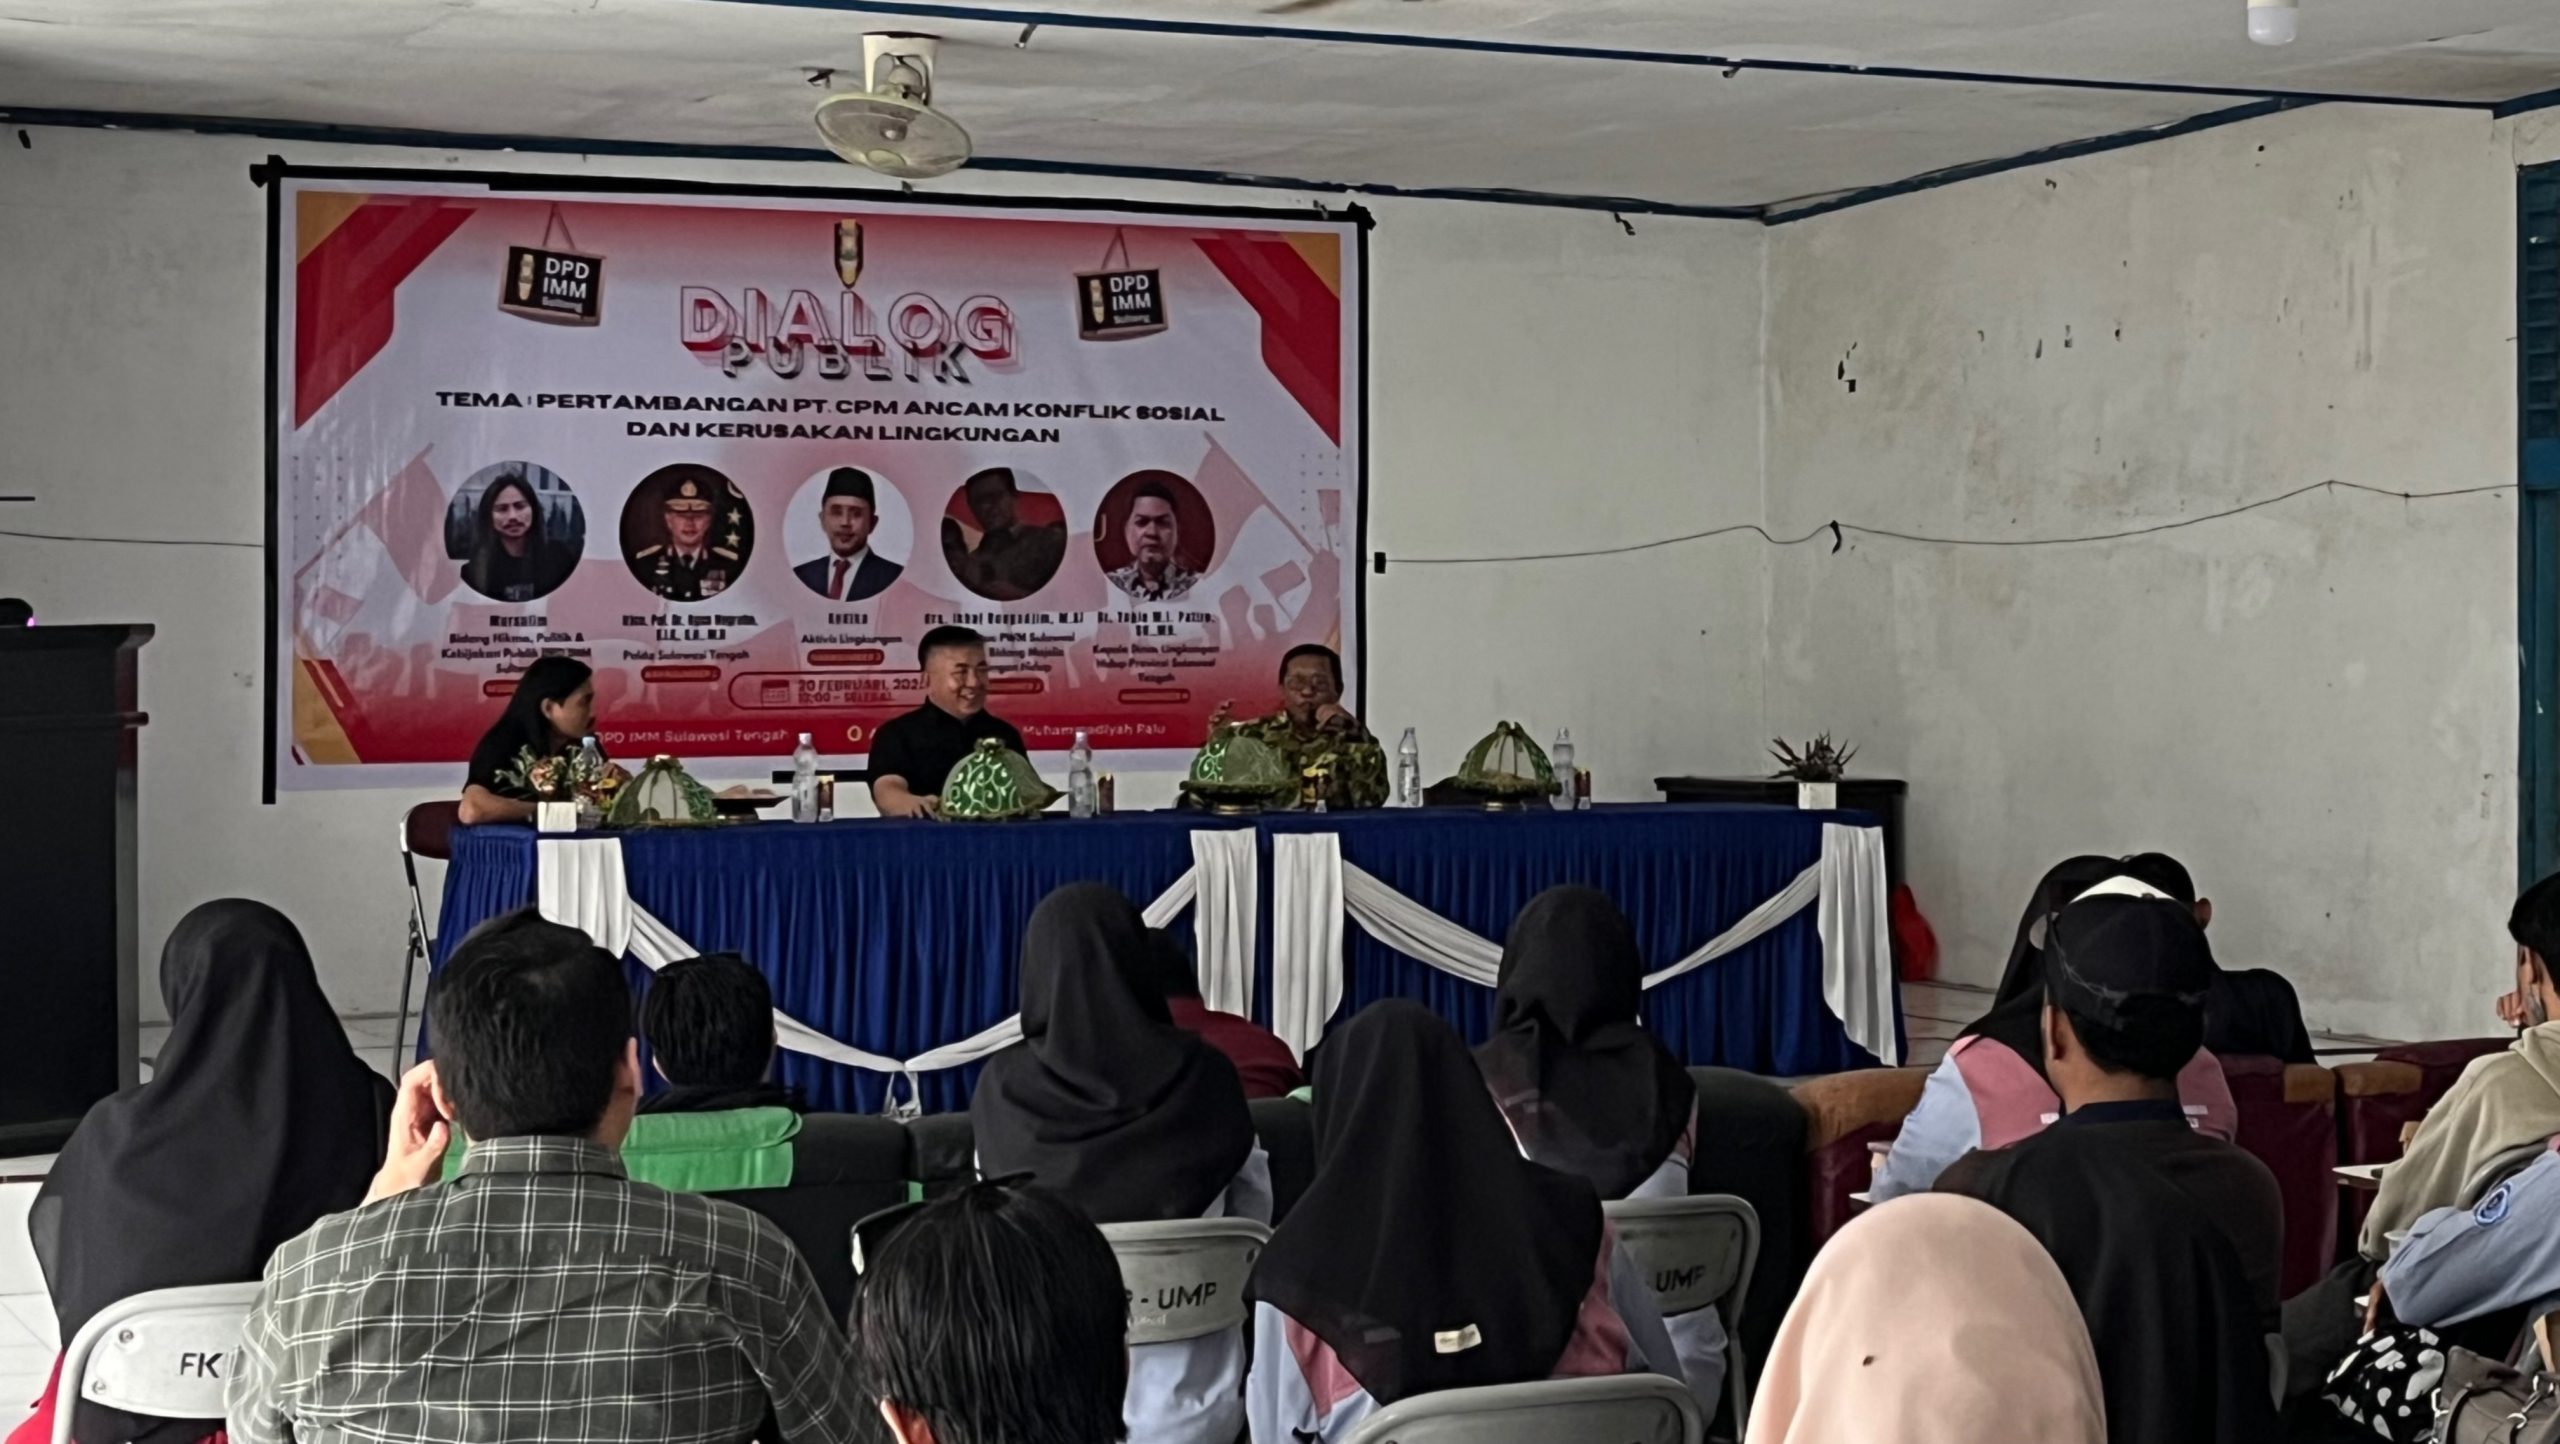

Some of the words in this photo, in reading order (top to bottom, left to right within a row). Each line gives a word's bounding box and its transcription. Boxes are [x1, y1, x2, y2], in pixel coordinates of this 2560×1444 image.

[545, 257, 589, 279] DPD
[542, 277, 586, 299] IMM
[1110, 275, 1149, 293] DPD
[1112, 293, 1151, 311] IMM
[680, 285, 1012, 361] DIALOG
[721, 336, 972, 385] PUBLIK
[436, 392, 523, 408] TEMA
[536, 394, 787, 414] PERTAMBANGAN
[835, 399, 898, 415] CPM
[904, 401, 1010, 418] ANCAM
[1013, 403, 1131, 420] KONFLIK
[1136, 406, 1226, 422] SOSIAL
[627, 421, 691, 438] DAN
[695, 422, 873, 440] KERUSAKAN
[879, 426, 1061, 444] LINGKUNGAN
[664, 730, 730, 743] Sulawesi
[1656, 1264, 1706, 1293] UMP
[1158, 1282, 1217, 1310] UMP
